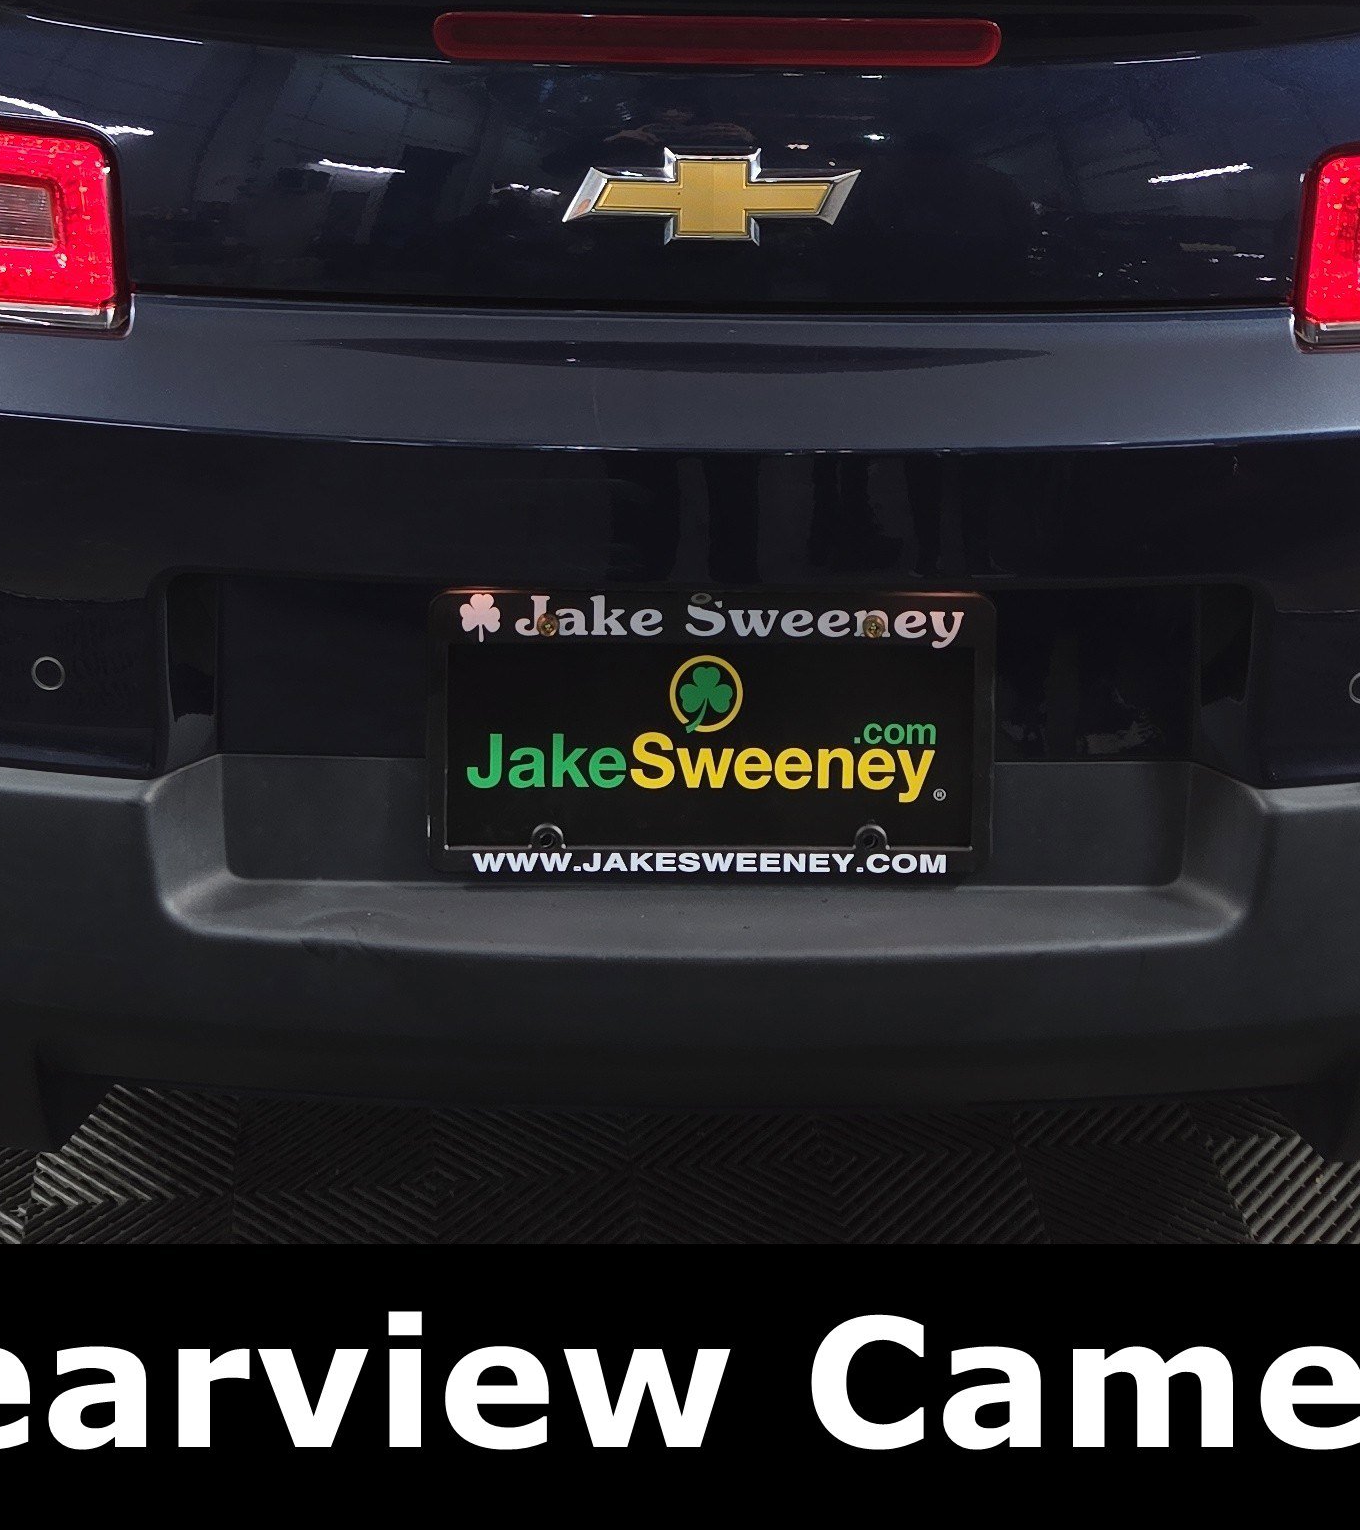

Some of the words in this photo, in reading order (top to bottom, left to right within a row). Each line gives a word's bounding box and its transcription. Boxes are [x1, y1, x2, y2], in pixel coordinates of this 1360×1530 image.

[515, 595, 664, 638] Jake
[685, 599, 965, 648] Sweeney
[854, 723, 937, 745] .com
[472, 852, 947, 874] WWW.JAKESWEENEY.COM
